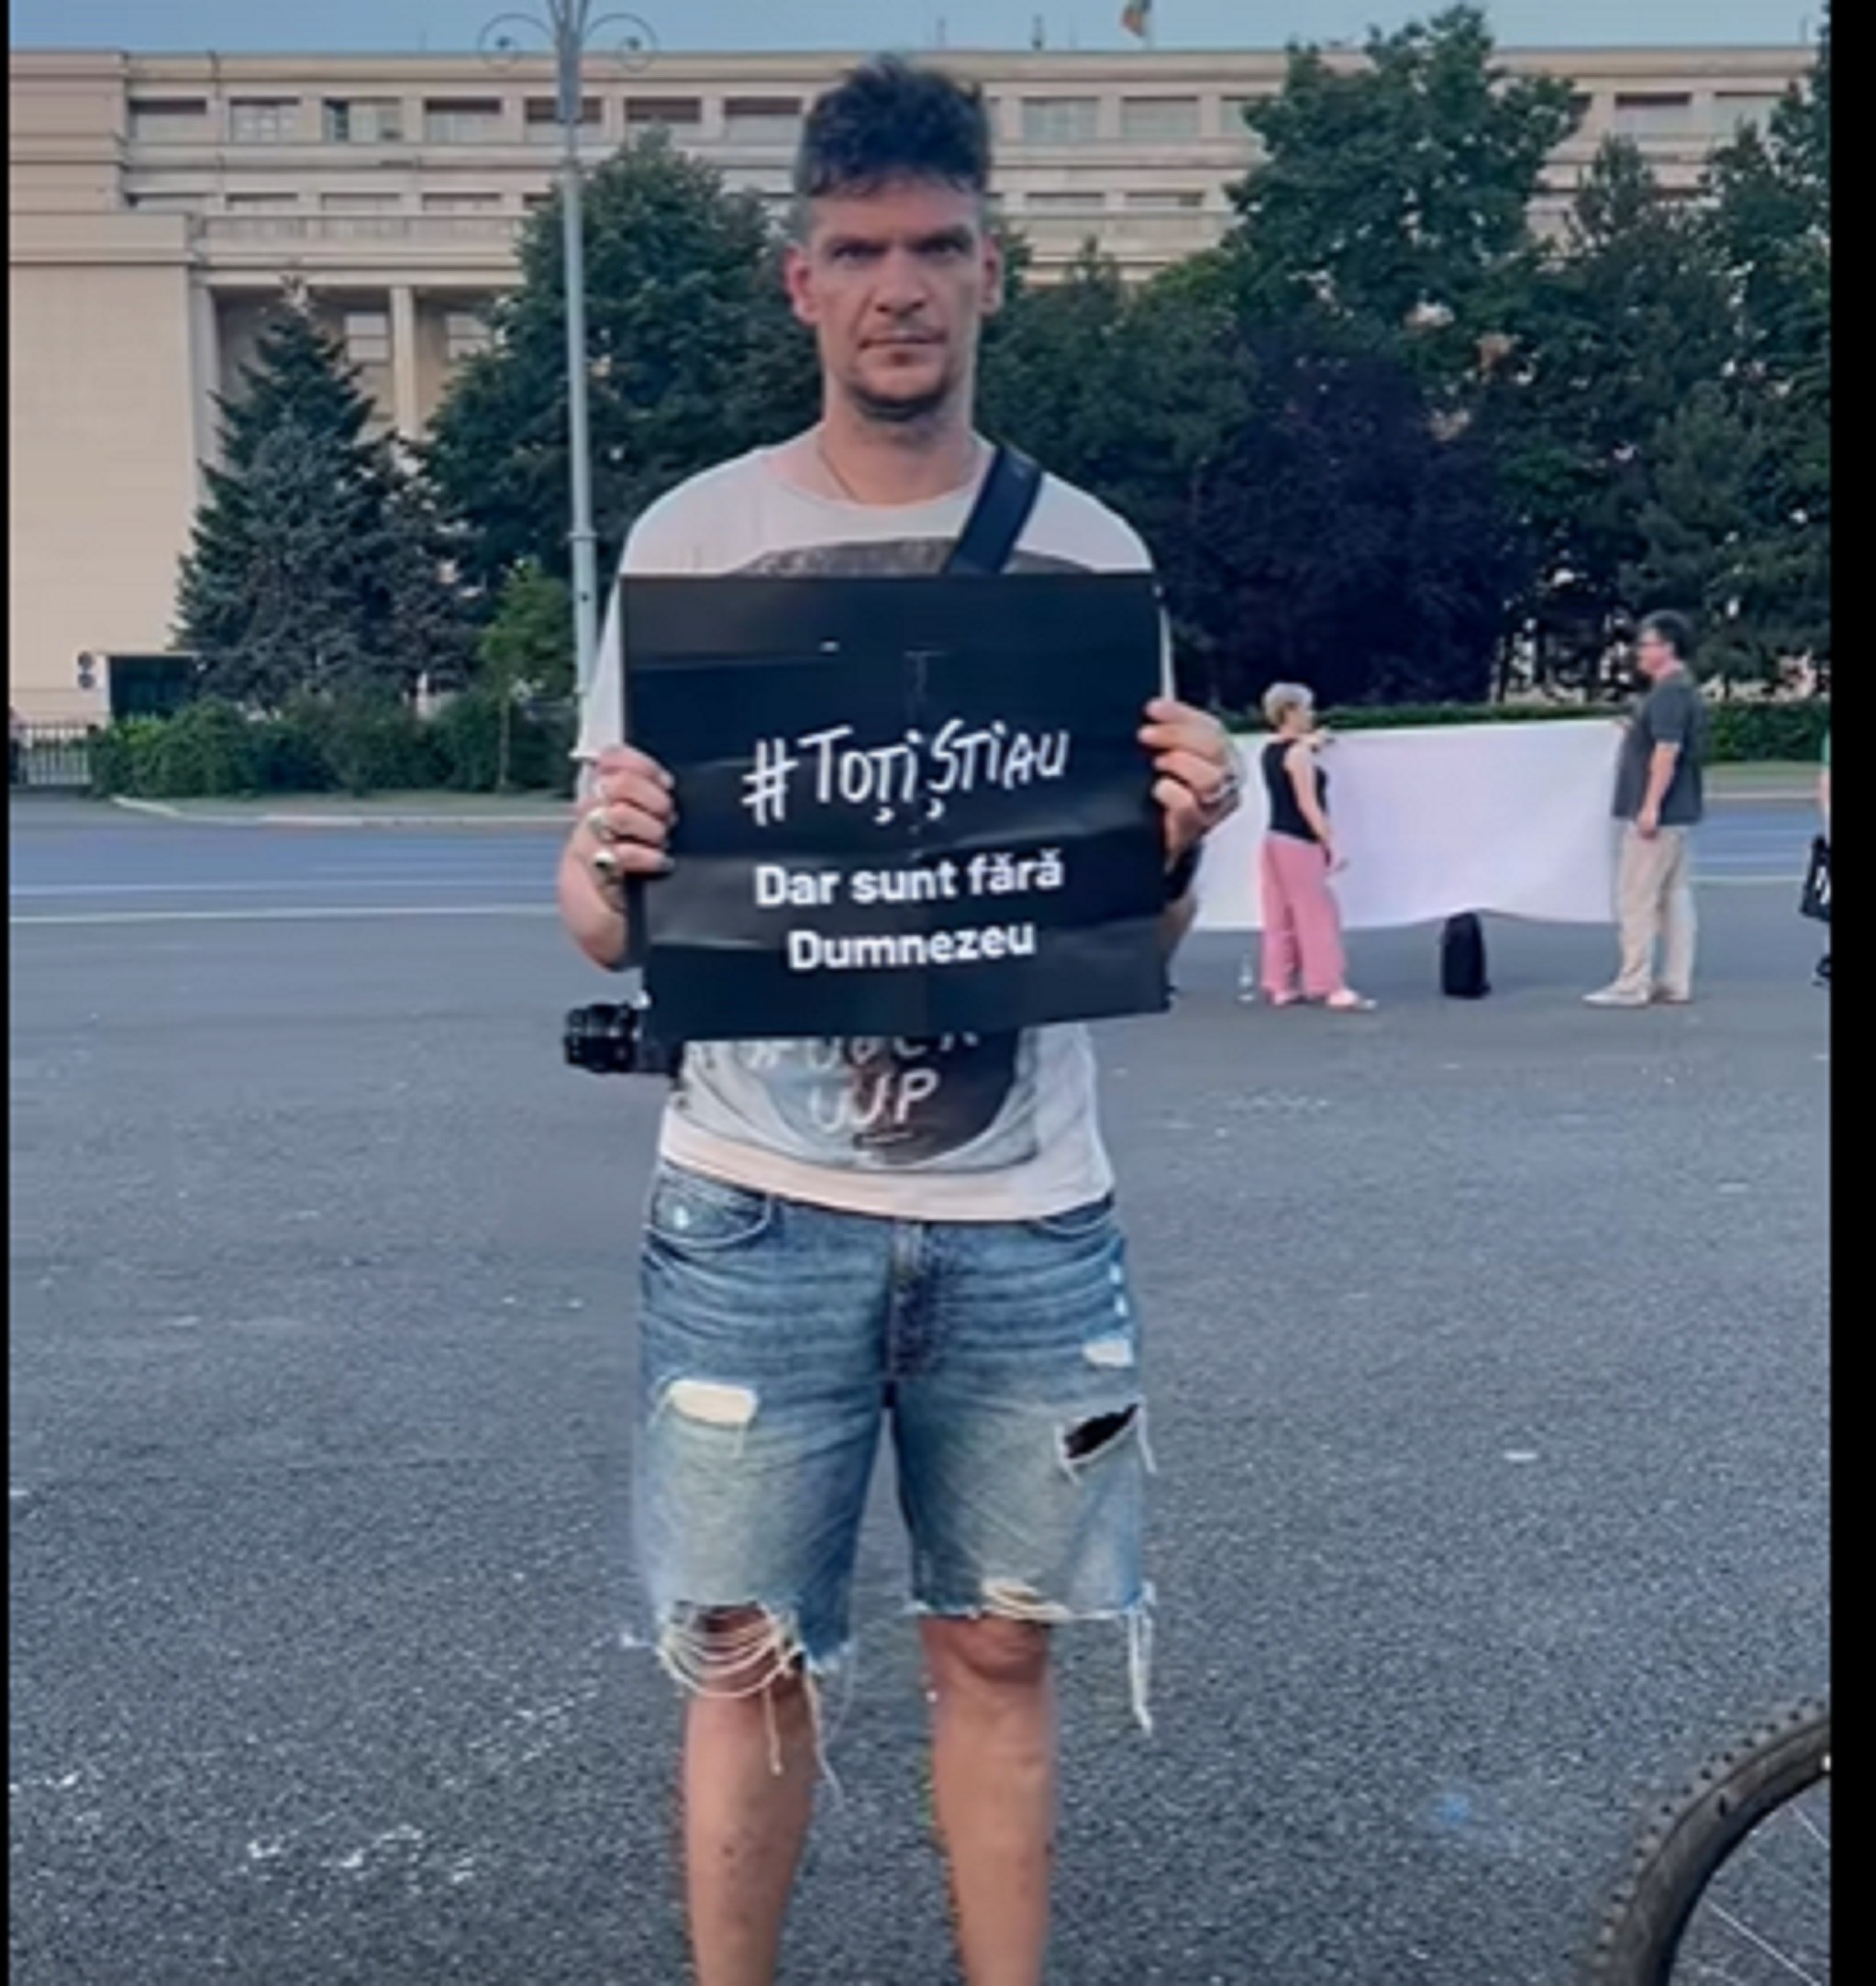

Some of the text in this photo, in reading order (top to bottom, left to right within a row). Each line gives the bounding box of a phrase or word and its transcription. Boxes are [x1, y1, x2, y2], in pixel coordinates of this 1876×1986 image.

[755, 850, 1063, 905] Dar sunt fără
[788, 924, 1036, 970] Dumnezeu
